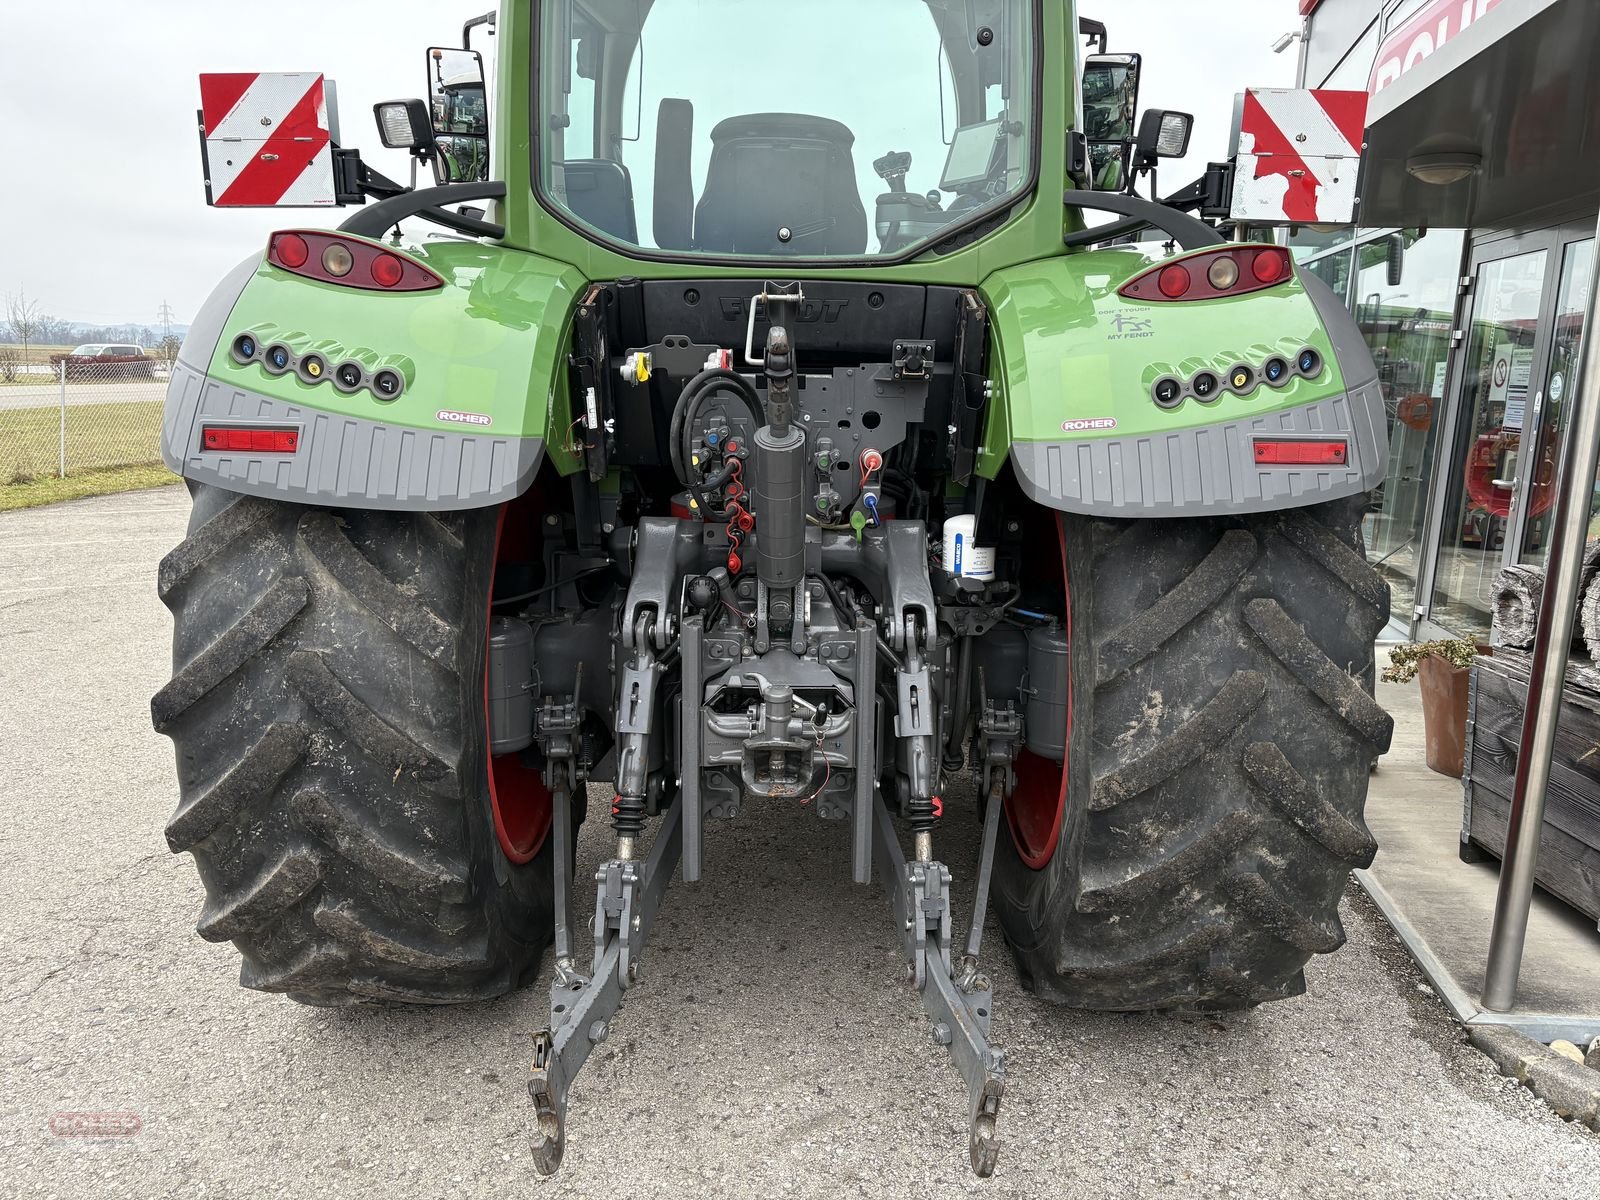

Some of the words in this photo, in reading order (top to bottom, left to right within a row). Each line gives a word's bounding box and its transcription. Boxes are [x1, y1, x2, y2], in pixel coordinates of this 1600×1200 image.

[719, 297, 849, 323] FEDT
[439, 411, 488, 424] ROHER
[1064, 419, 1114, 430] ROHER
